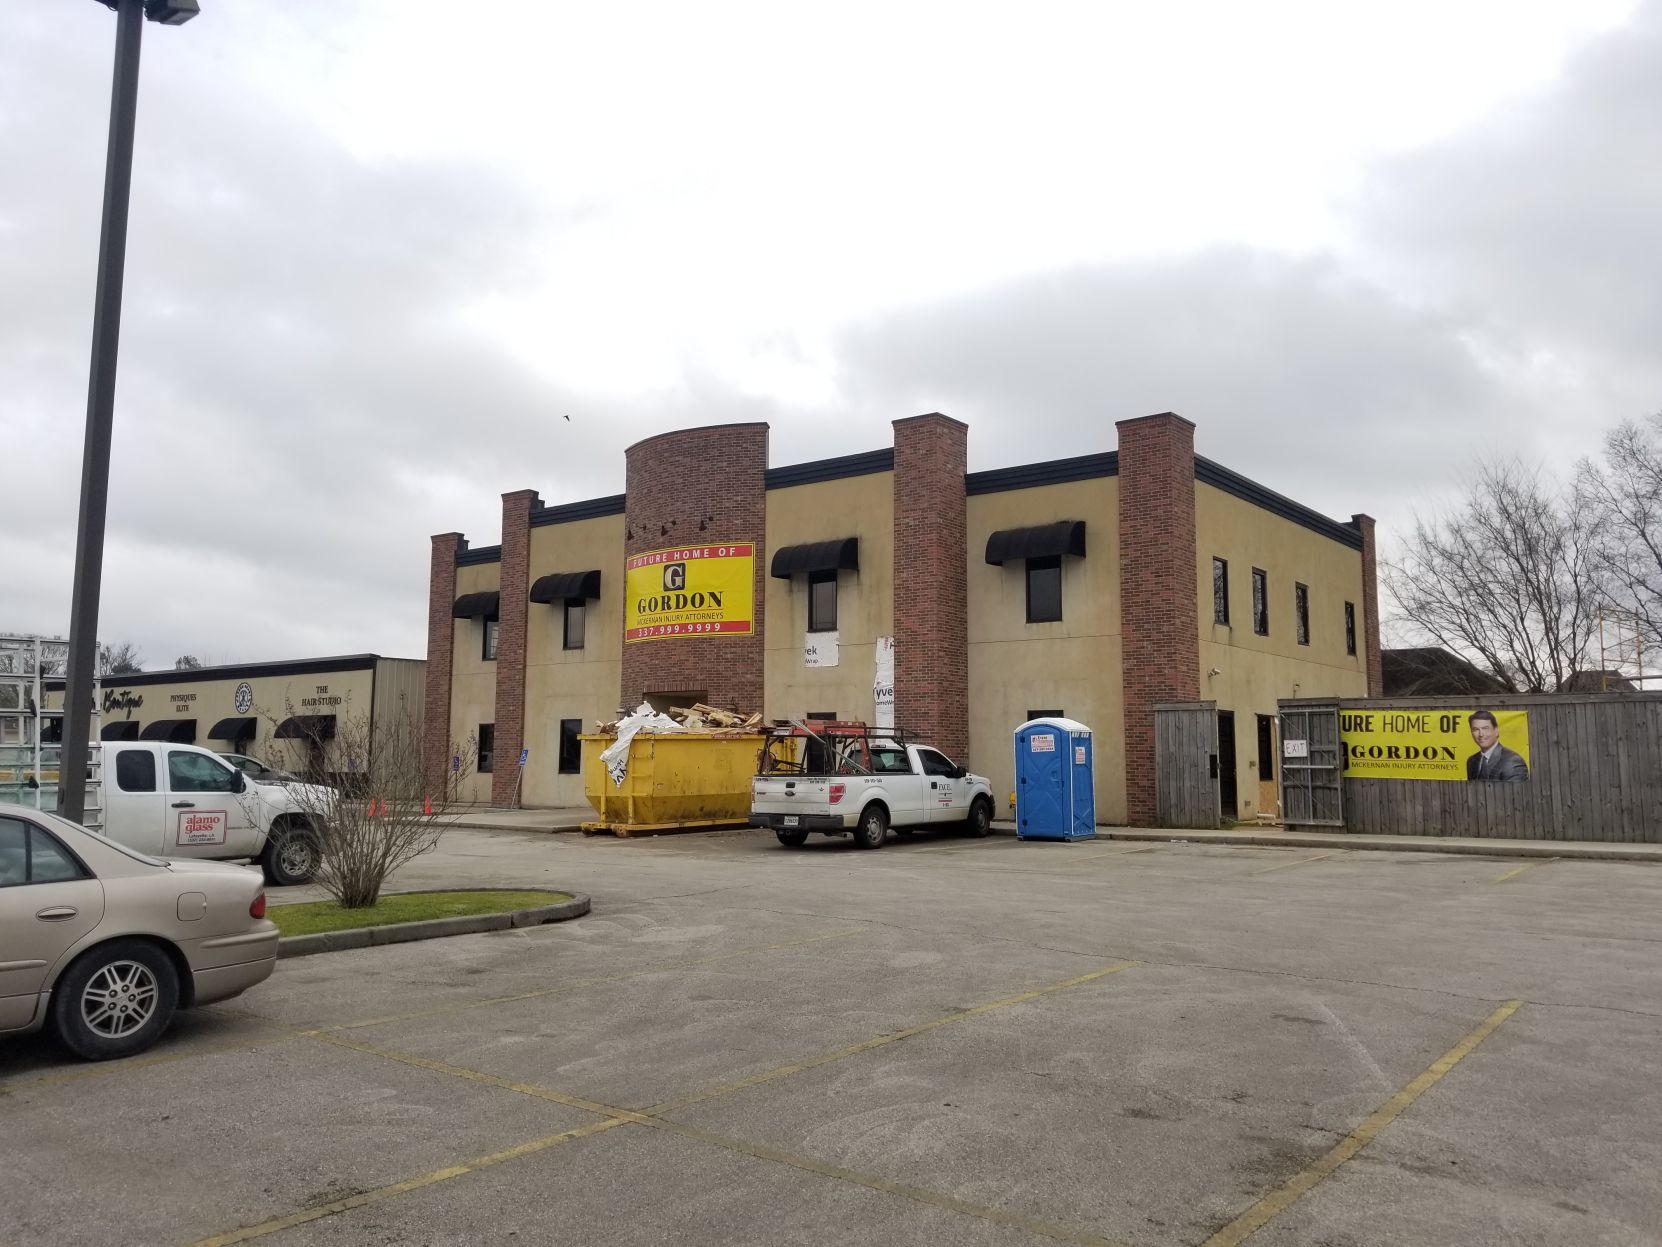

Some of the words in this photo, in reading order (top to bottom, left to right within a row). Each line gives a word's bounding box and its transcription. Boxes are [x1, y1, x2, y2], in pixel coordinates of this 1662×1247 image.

[633, 553, 668, 568] FUTURE
[674, 548, 709, 560] HOME
[718, 547, 736, 557] OF
[664, 565, 685, 590] G
[637, 591, 724, 614] GORDON
[664, 614, 684, 623] INJURY
[685, 612, 724, 621] ATTORNEYS
[638, 622, 721, 637] 337.999.9999
[315, 685, 329, 694] THE
[103, 688, 144, 720] Boutique
[301, 698, 317, 707] HAIR
[317, 696, 342, 706] STUDIO
[176, 704, 190, 713] ELITE
[1382, 714, 1431, 733] HOME
[1440, 714, 1462, 733] OF
[1285, 742, 1305, 755] EXIT
[1350, 744, 1457, 761] GORDON
[1351, 761, 1391, 769] MCKERNAN
[1392, 762, 1416, 770] INJURY
[1418, 763, 1459, 771] ATTORNEYS
[186, 814, 220, 825] alamo
[185, 823, 214, 835] glass
